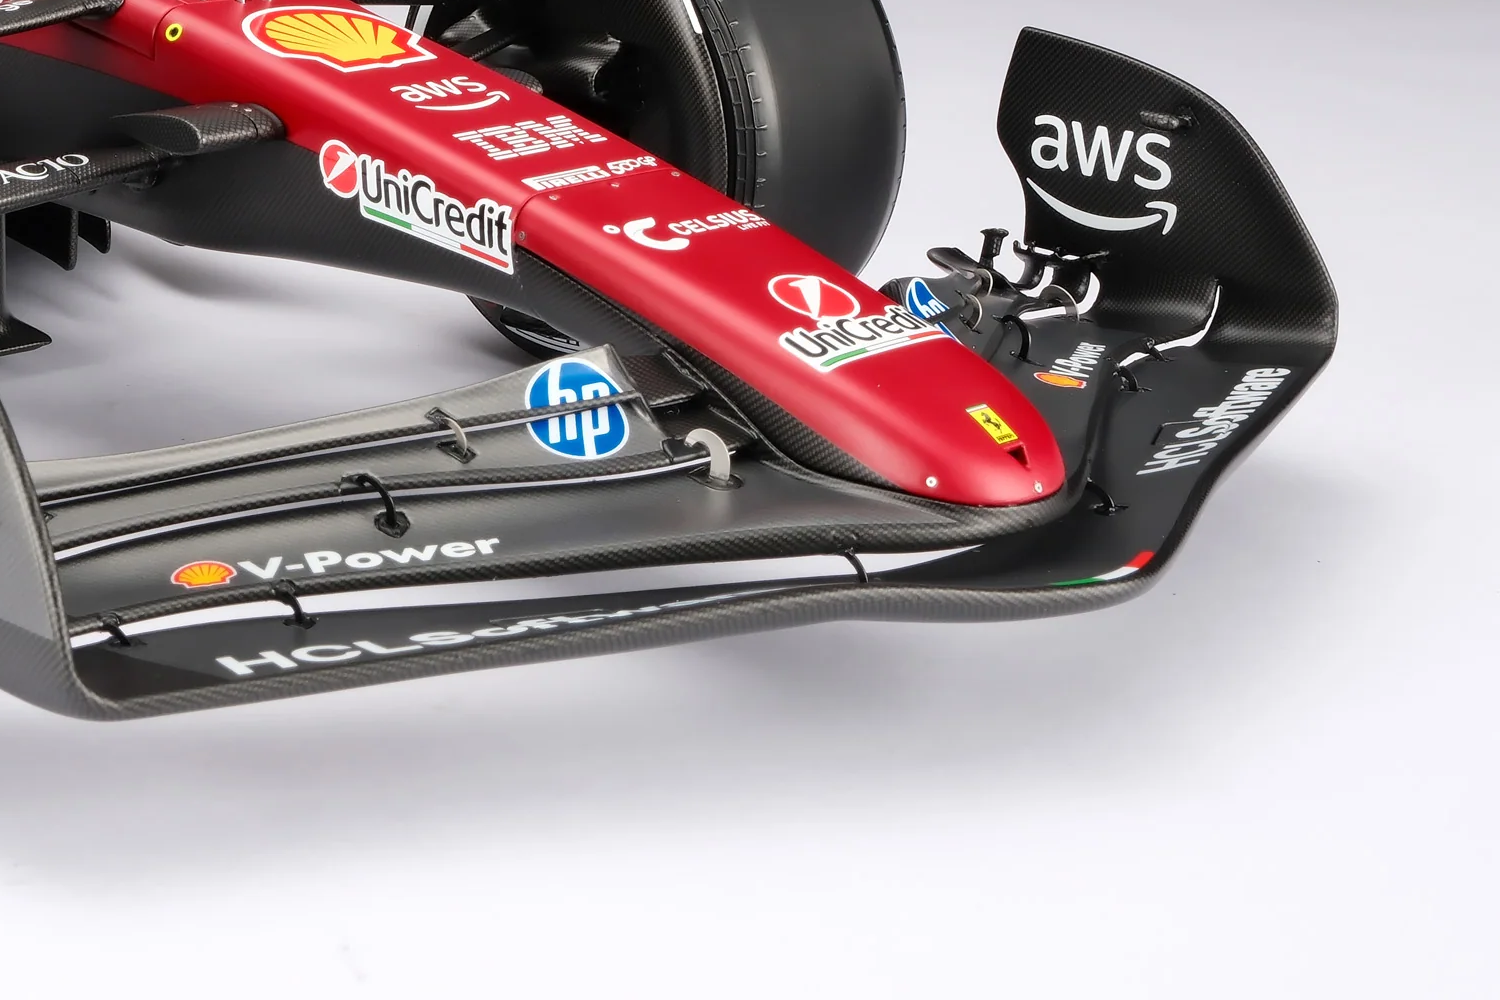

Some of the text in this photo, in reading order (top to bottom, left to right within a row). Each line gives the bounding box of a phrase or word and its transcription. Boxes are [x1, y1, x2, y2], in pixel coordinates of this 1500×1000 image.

[390, 75, 487, 102] aws
[452, 115, 609, 161] IBM
[1030, 114, 1173, 191] aws
[521, 165, 612, 191] PIRELLI
[361, 158, 508, 256] UniCredit
[784, 306, 932, 358] UniCredi
[1048, 342, 1107, 378] V-Power
[1135, 366, 1291, 476] HCLSoftware
[236, 537, 501, 579] V-Power
